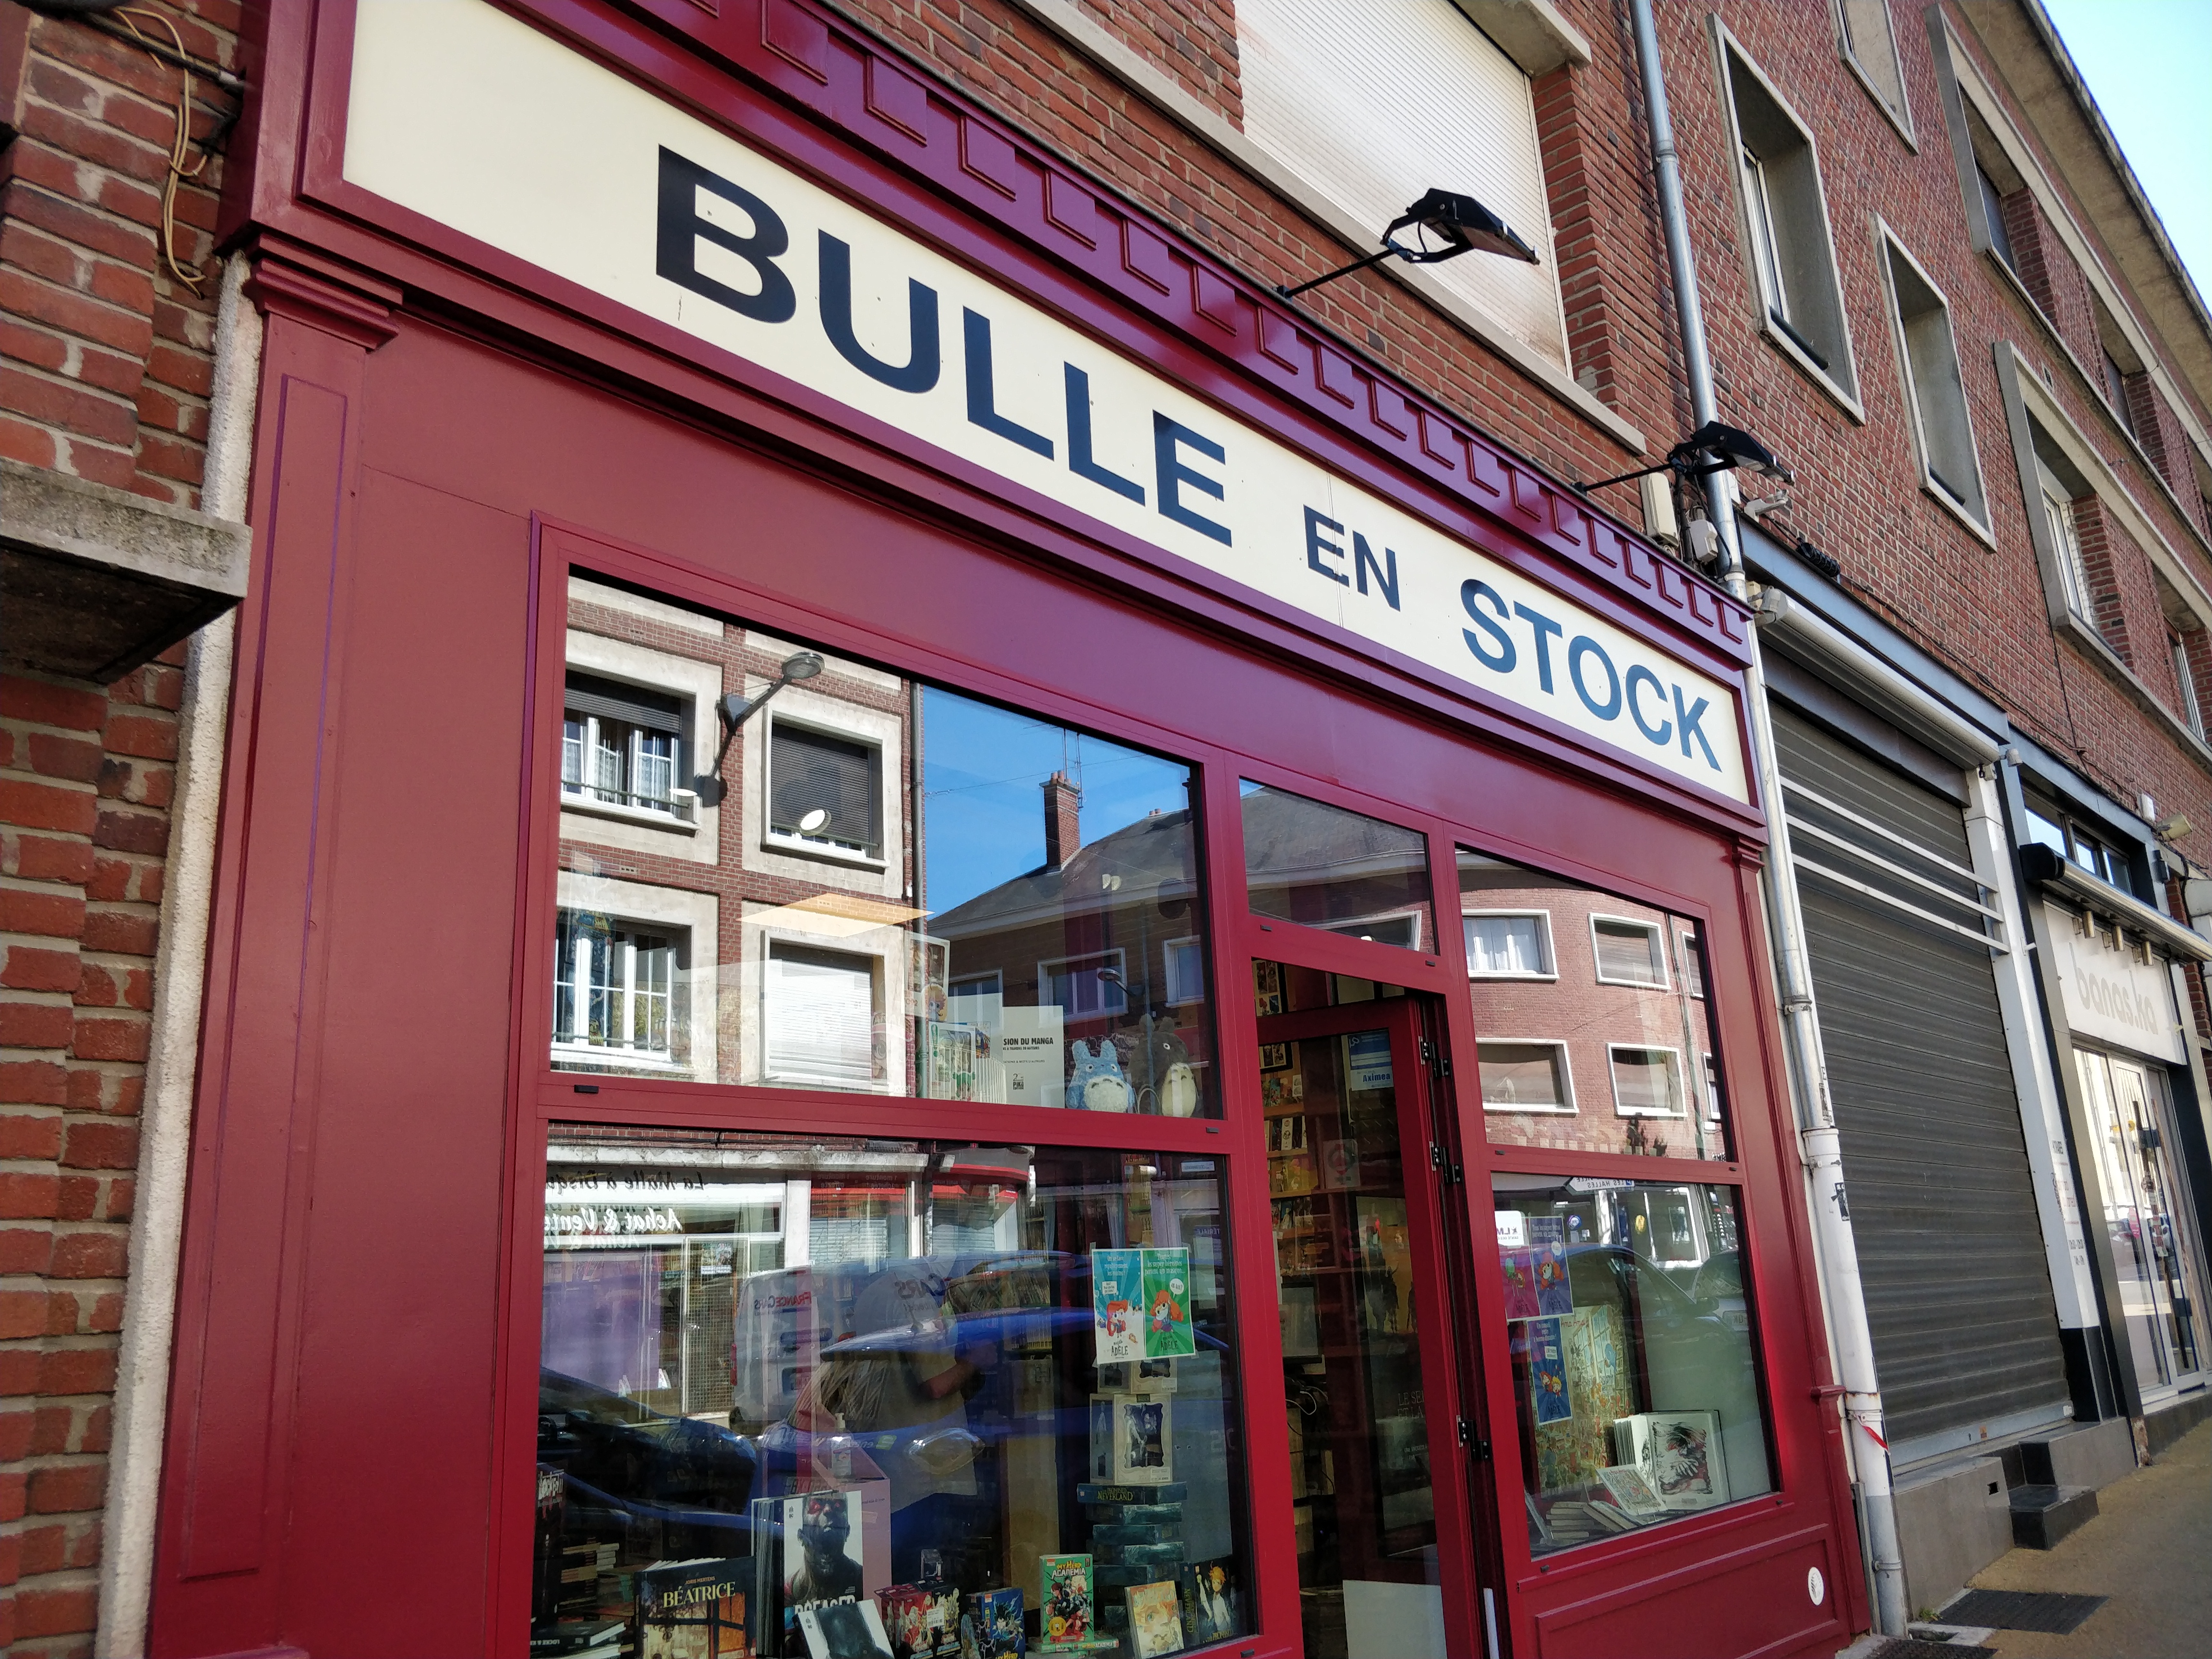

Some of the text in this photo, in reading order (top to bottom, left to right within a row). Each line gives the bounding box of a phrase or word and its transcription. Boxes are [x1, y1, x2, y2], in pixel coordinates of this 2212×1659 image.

[656, 143, 1722, 772] BULLE EN STOCK
[1032, 1037, 1054, 1045] MANGA
[1363, 1073, 1391, 1082] Aximea
[1111, 1345, 1129, 1357] ADÈLE
[1398, 1392, 1409, 1406] LE
[1397, 1407, 1409, 1422] ET
[1097, 1490, 1133, 1501] NEVERLAND
[1051, 1567, 1086, 1580] ACADEMIA
[663, 1581, 736, 1609] BÉATRICE
